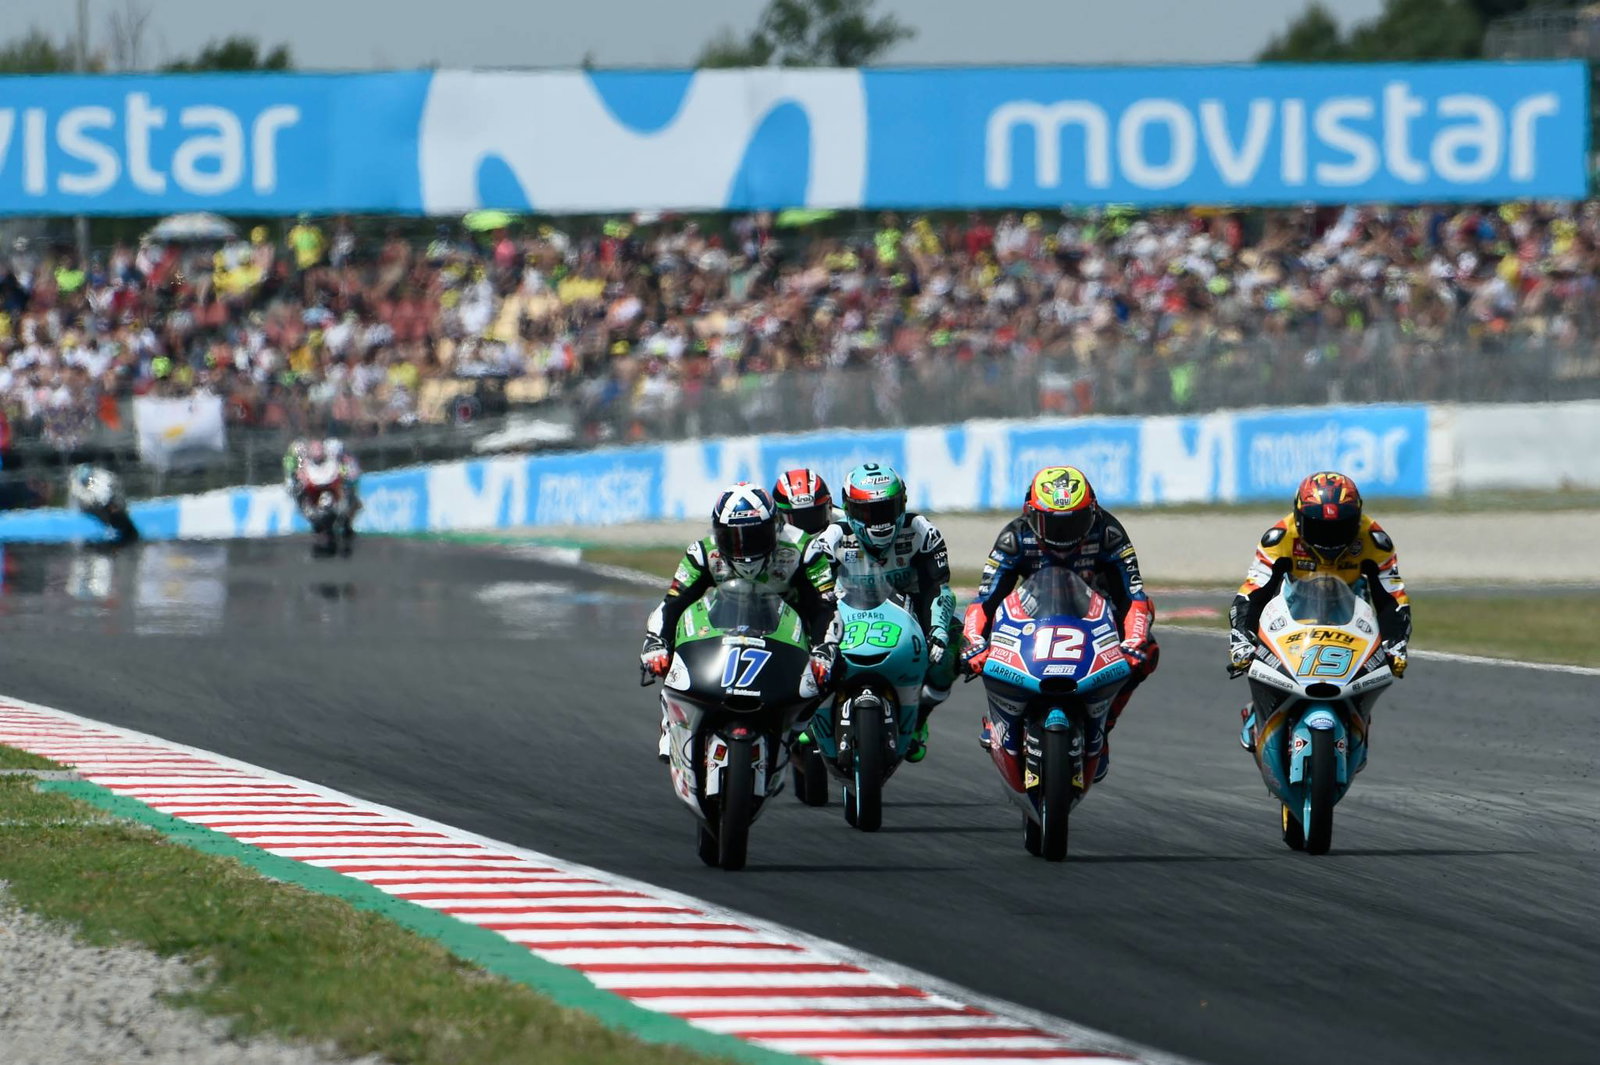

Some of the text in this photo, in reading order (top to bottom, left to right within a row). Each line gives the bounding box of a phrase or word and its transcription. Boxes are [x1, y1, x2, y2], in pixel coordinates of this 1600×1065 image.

[0, 93, 299, 195] istar
[985, 81, 1559, 189] movistar
[847, 611, 885, 621] LEOPARD
[839, 620, 902, 650] 33
[1033, 626, 1085, 661] 12
[721, 647, 772, 687] 17
[989, 664, 1025, 686] JARRITOS
[1091, 666, 1125, 688] JARRITOS
[1297, 645, 1357, 677] 19
